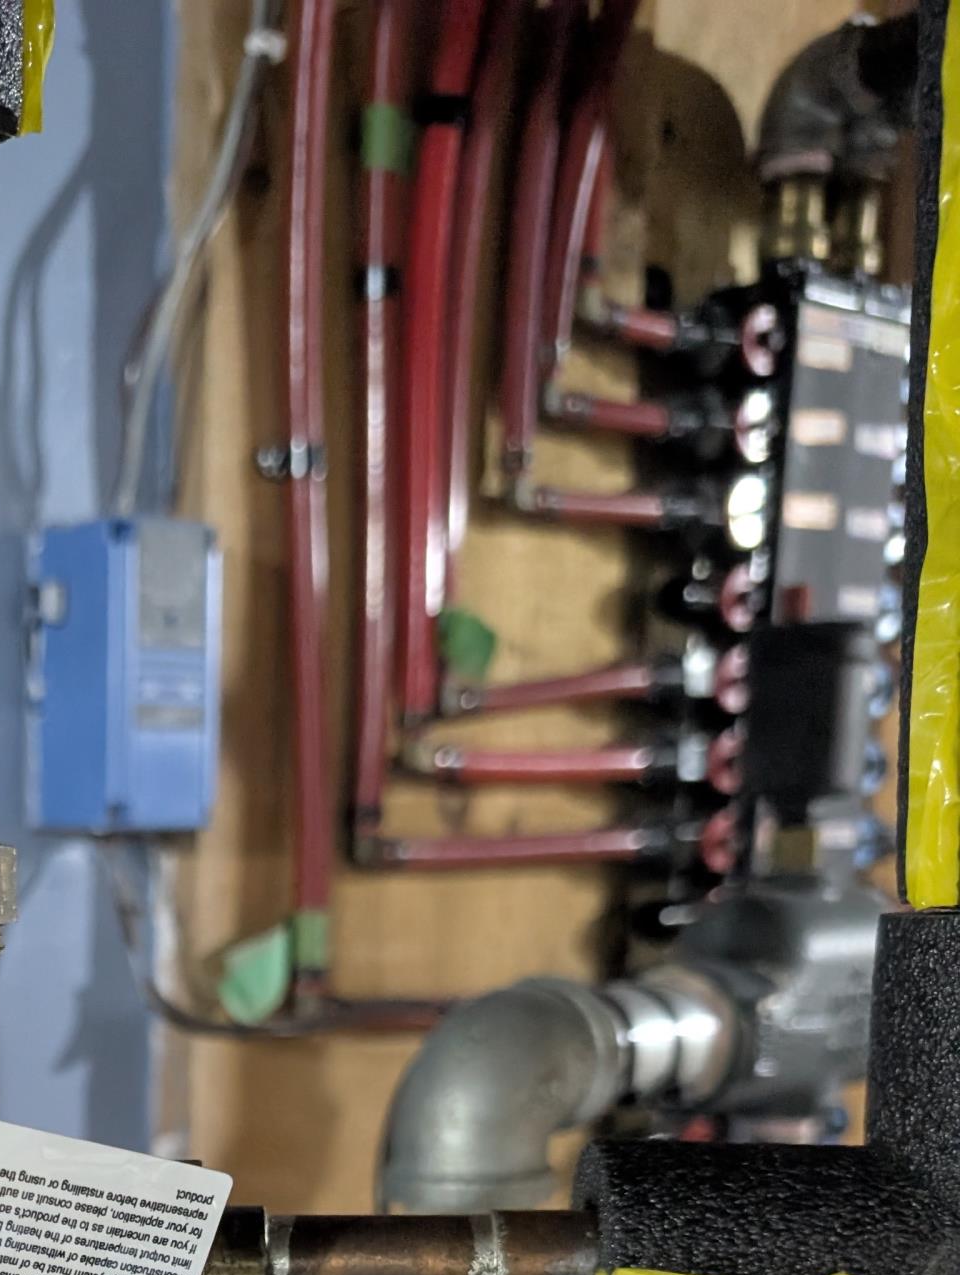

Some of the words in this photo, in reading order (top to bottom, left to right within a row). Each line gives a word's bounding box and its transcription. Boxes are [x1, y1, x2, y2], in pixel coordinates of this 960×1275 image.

[0, 1169, 17, 1182] the
[18, 1170, 46, 1186] using
[48, 1180, 60, 1189] or
[61, 1180, 105, 1199] installing
[22, 1192, 35, 1201] an
[36, 1194, 73, 1209] consult
[106, 1192, 139, 1209] before
[75, 1203, 109, 1218] please
[140, 1200, 209, 1221] representative
[6, 1220, 43, 1240] heating
[62, 1217, 78, 1230] the
[80, 1221, 90, 1232] to
[92, 1224, 105, 1233] as
[165, 1222, 189, 1234] your
[44, 1231, 60, 1243] the
[60, 1235, 73, 1245] of
[106, 1226, 151, 1242] uncertain
[189, 1227, 203, 1240] for
[74, 1237, 139, 1258] temperatures
[152, 1236, 170, 1247] are
[170, 1240, 190, 1251] you
[5, 1237, 66, 1260] withstanding
[189, 1244, 198, 1255] If
[66, 1253, 79, 1263] of
[80, 1255, 119, 1270] capable
[140, 1250, 171, 1264] output
[172, 1257, 192, 1270] limit
[19, 1260, 31, 1270] of
[32, 1262, 46, 1274] be
[47, 1265, 73, 1275] must
